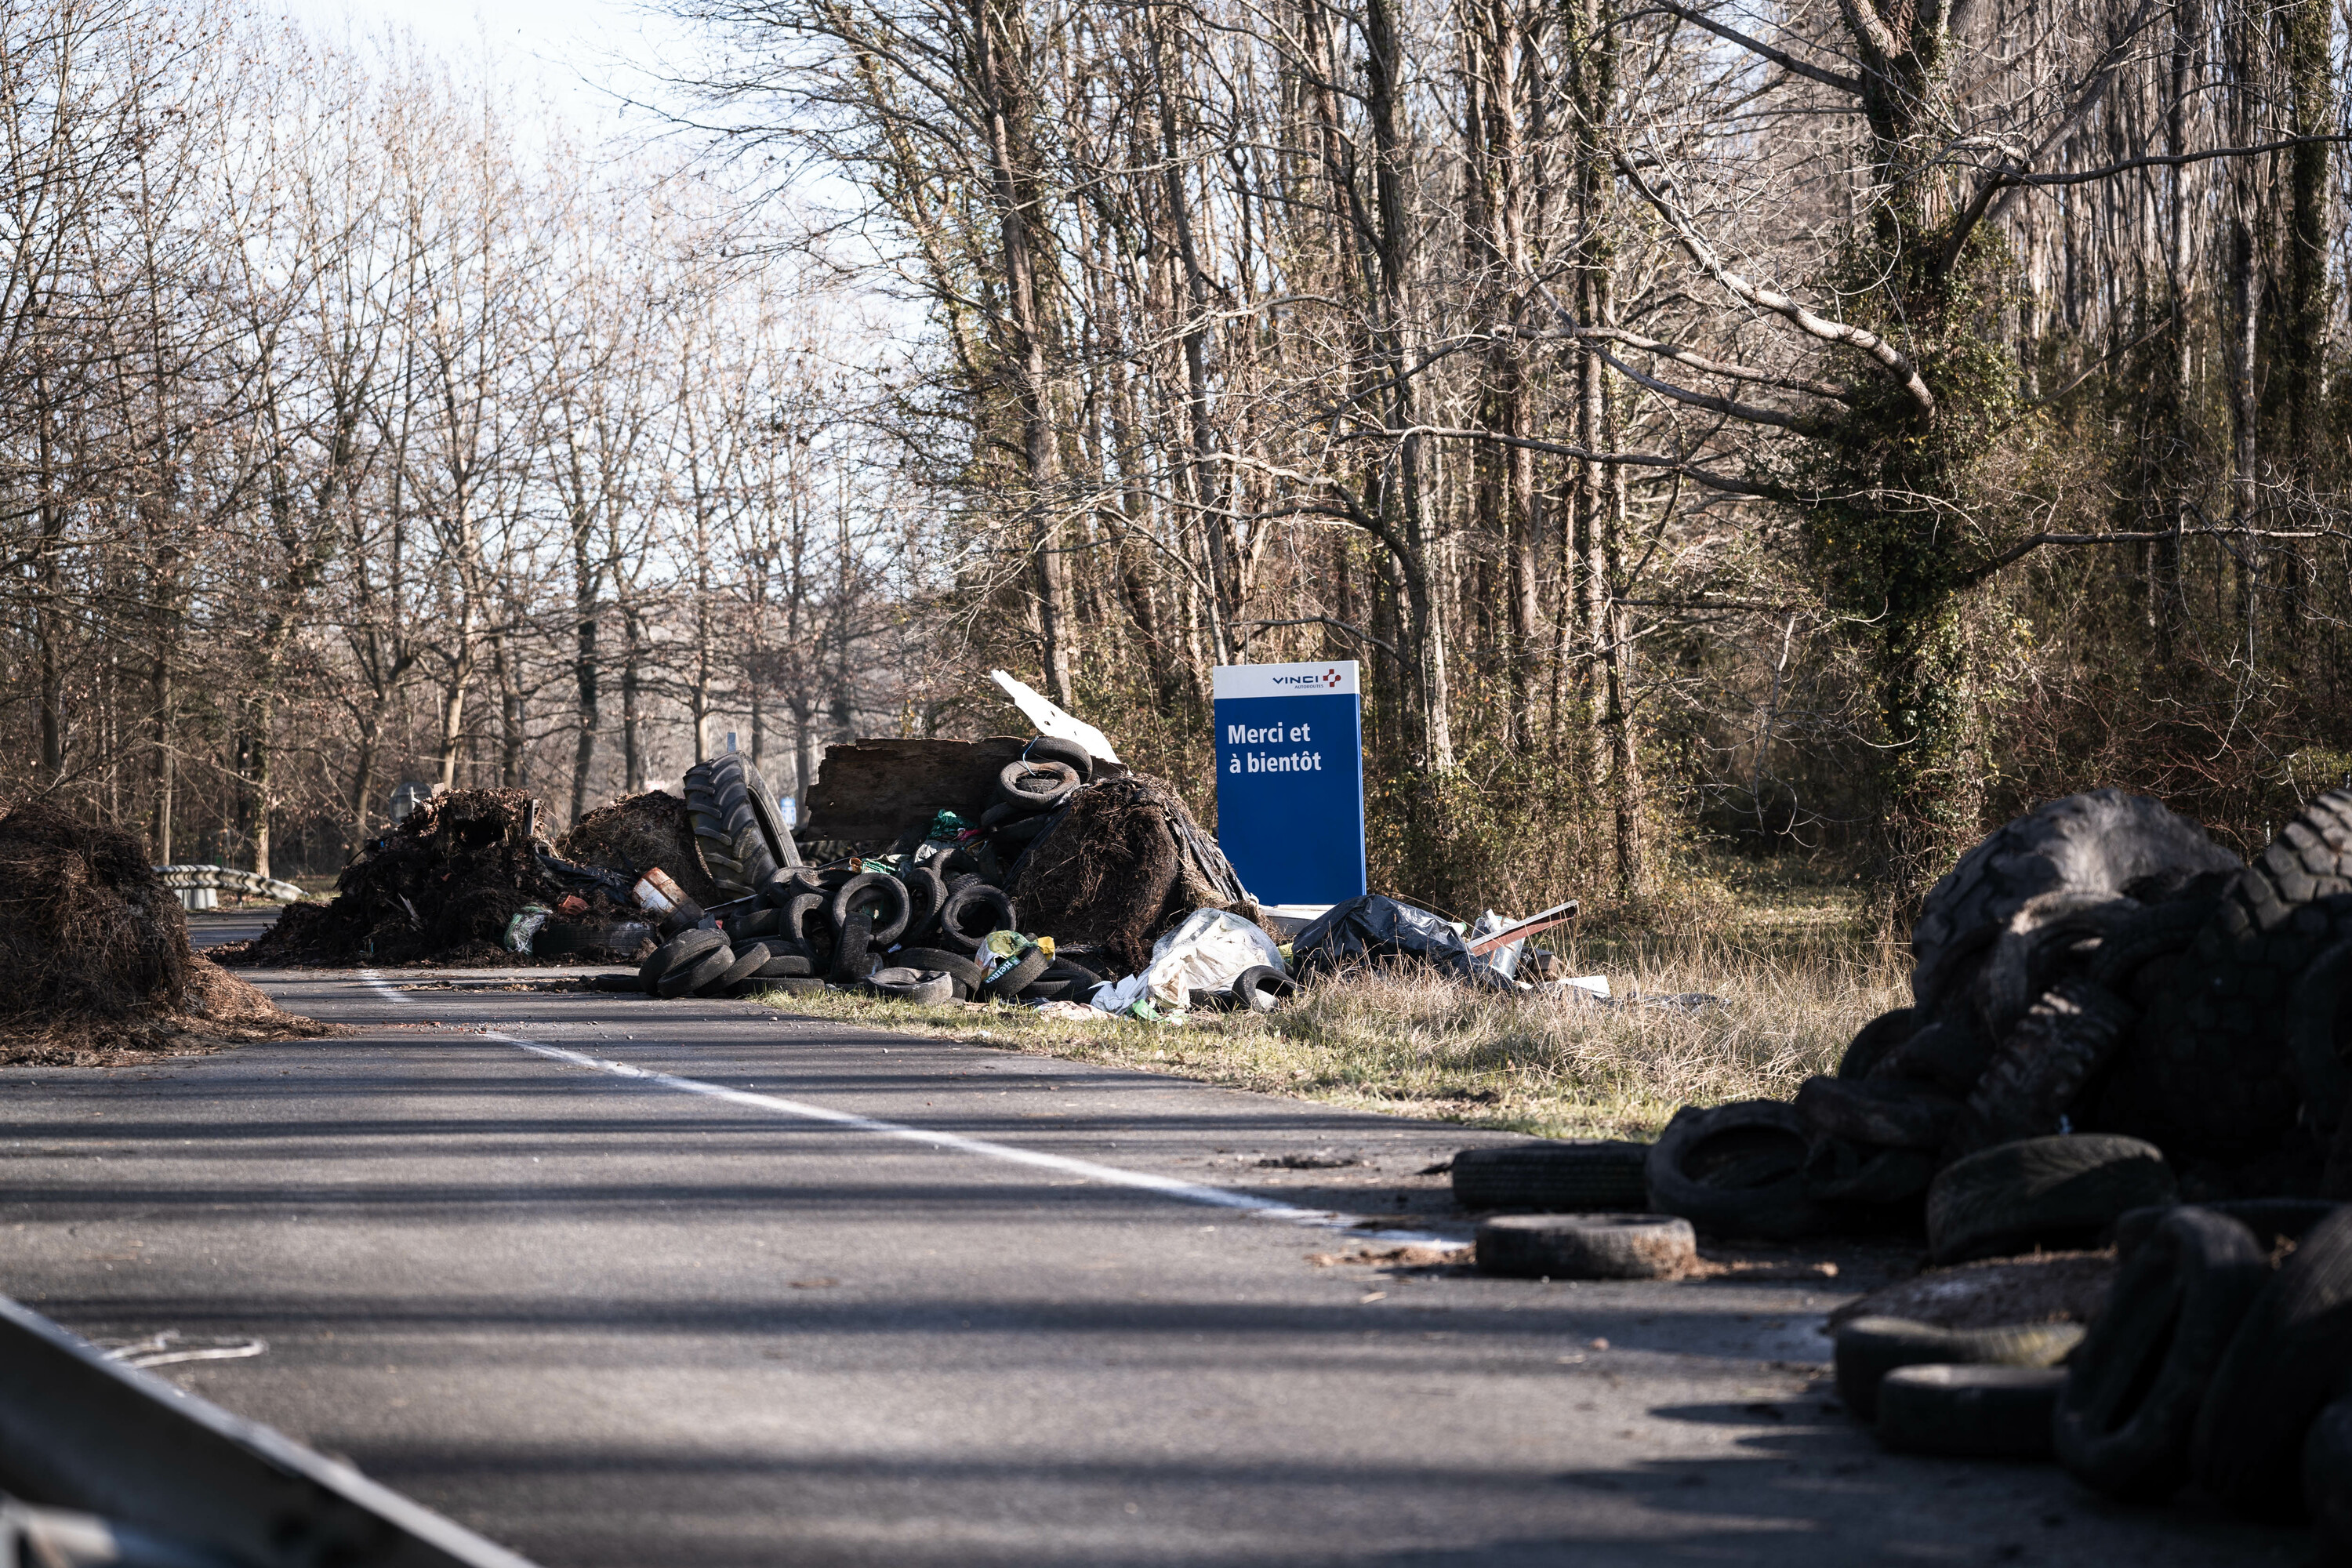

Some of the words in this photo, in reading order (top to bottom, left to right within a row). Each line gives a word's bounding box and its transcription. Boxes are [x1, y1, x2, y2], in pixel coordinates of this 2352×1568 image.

[1272, 675, 1319, 684] VINCI
[1228, 722, 1283, 744] Merci
[1290, 723, 1311, 742] et
[1229, 753, 1241, 774] à
[1247, 750, 1322, 773] bientôt
